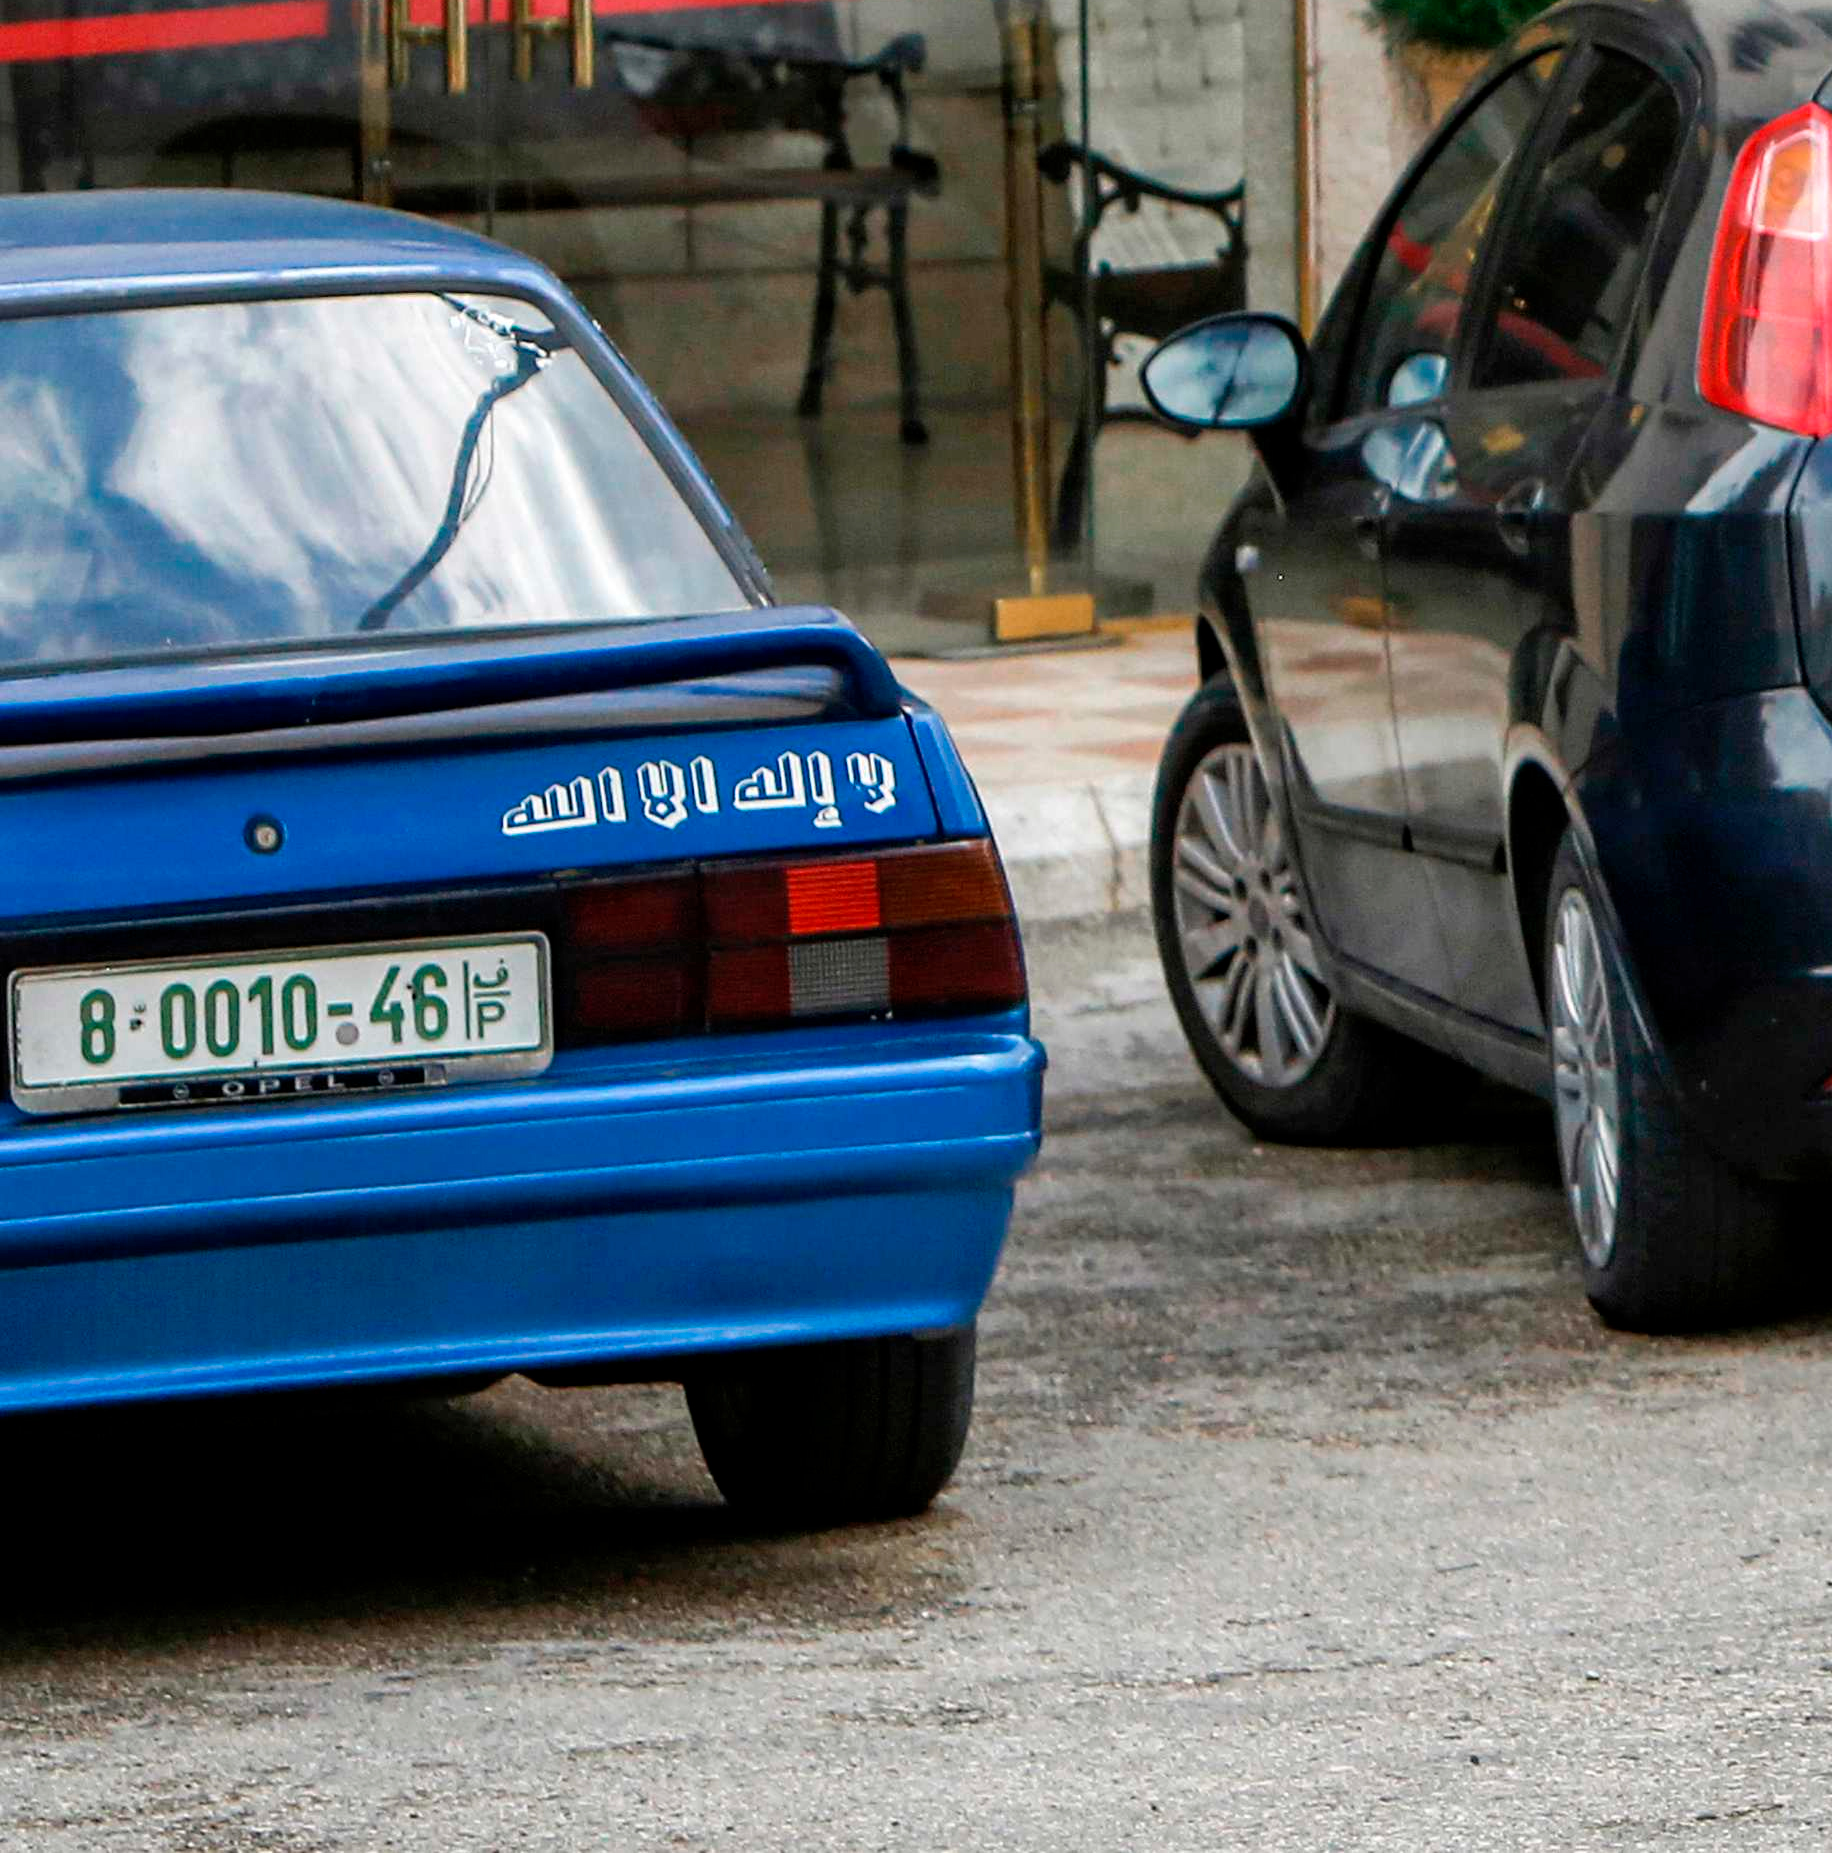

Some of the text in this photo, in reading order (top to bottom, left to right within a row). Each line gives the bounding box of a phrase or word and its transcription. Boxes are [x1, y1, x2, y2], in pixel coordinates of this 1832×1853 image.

[501, 765, 627, 837] الله
[477, 999, 507, 1040] P
[221, 1073, 346, 1098] OPEL
